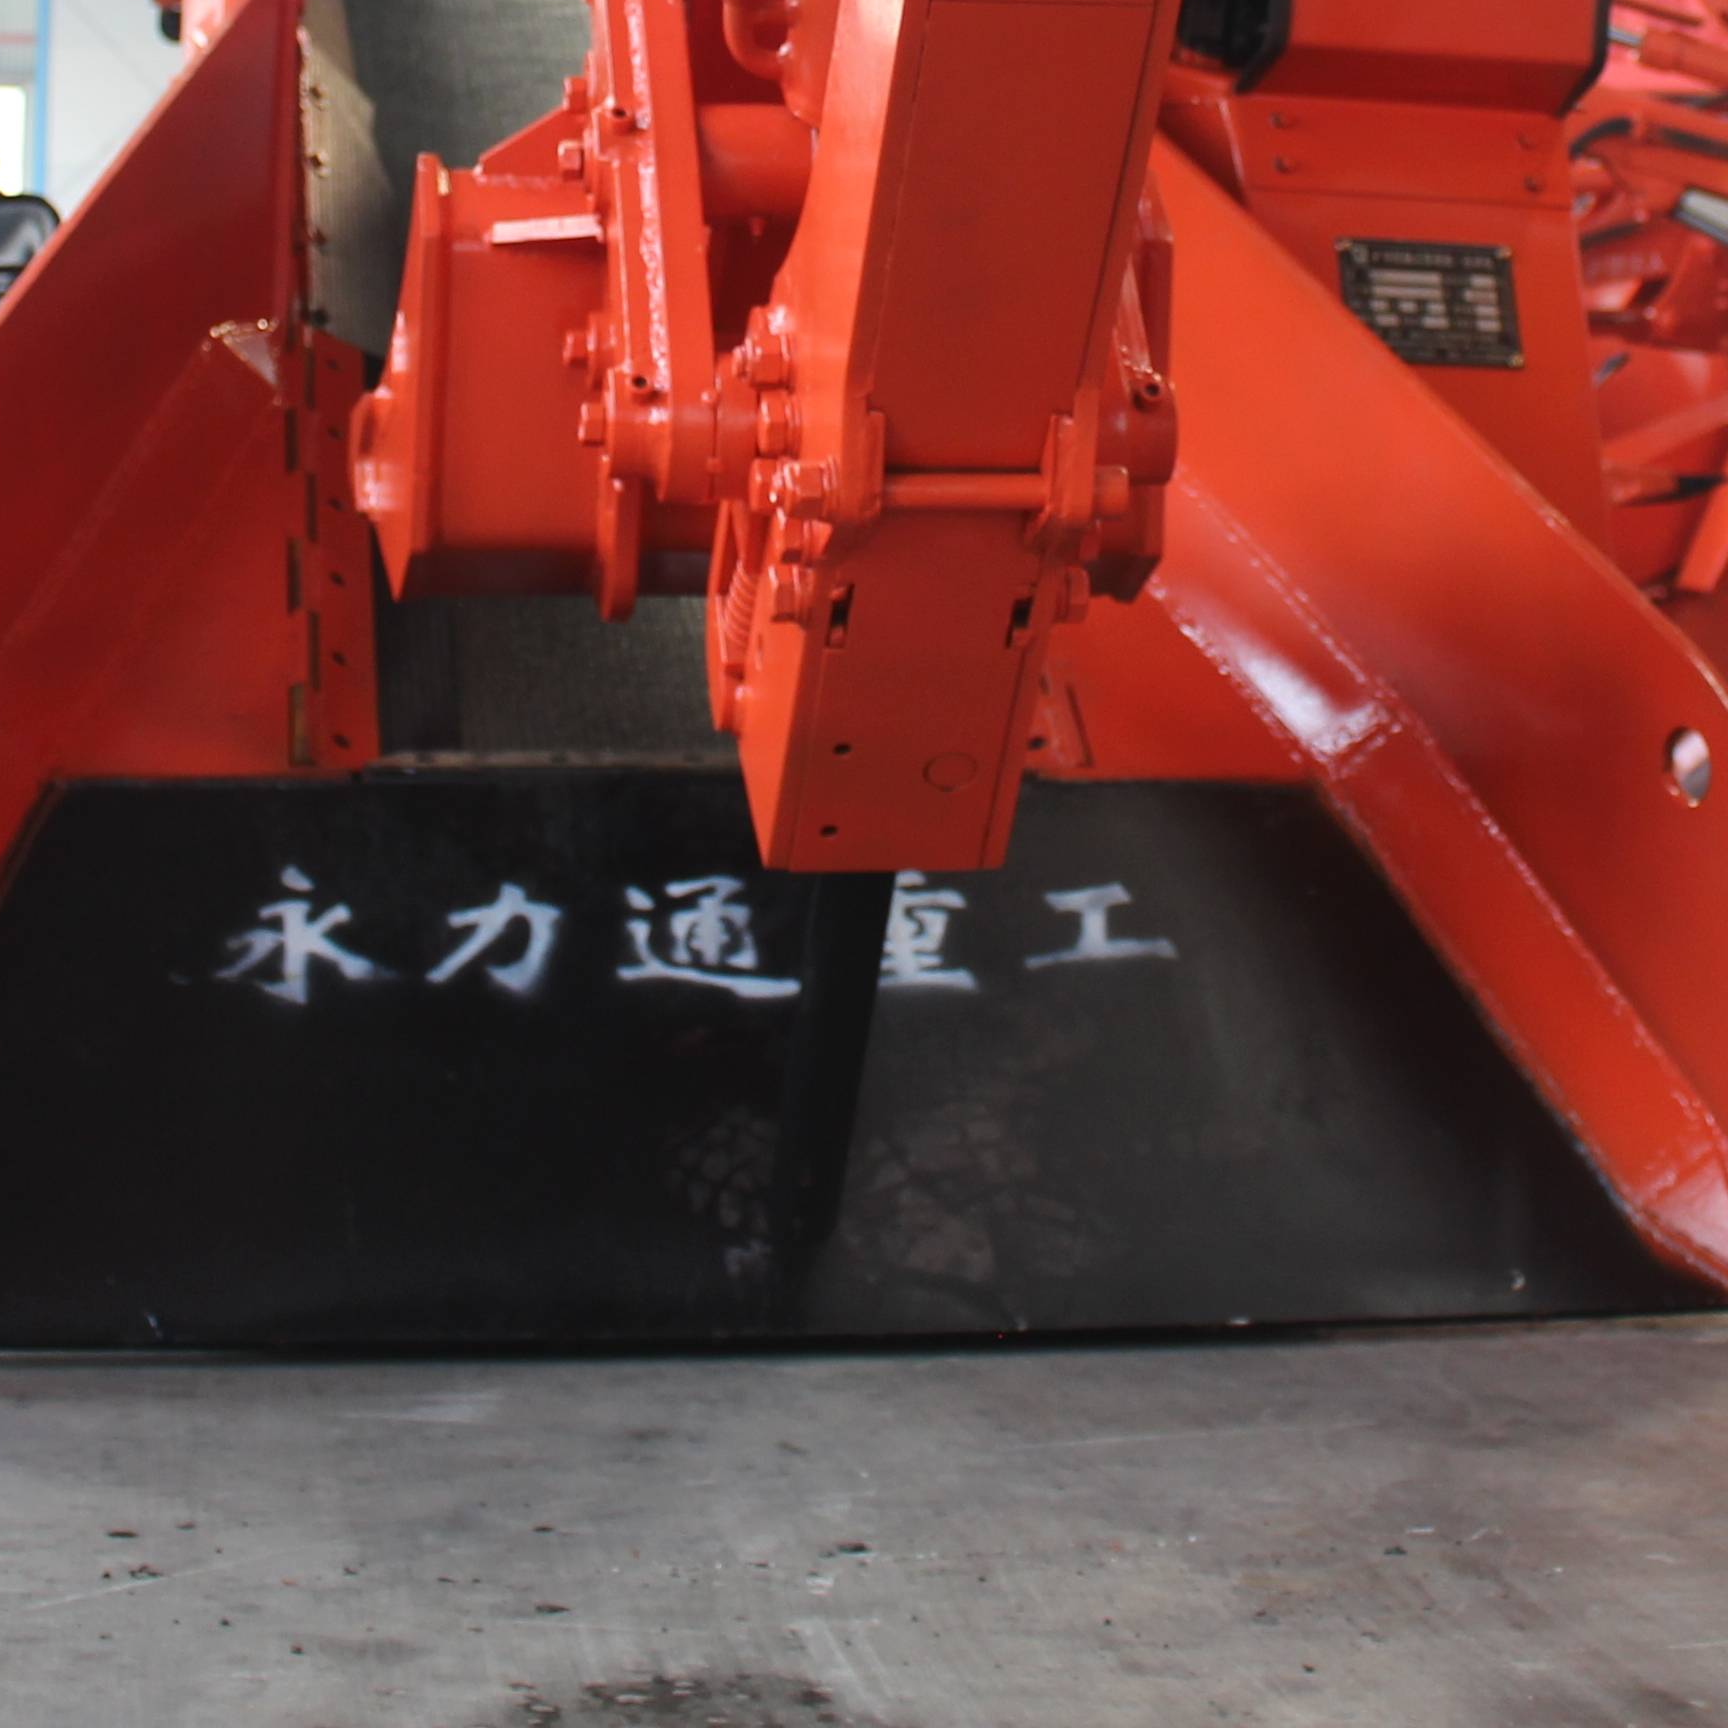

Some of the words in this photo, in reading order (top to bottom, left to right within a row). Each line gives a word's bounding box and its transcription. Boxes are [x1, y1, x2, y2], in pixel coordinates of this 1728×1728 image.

[210, 864, 1179, 1005] 永力通重工
